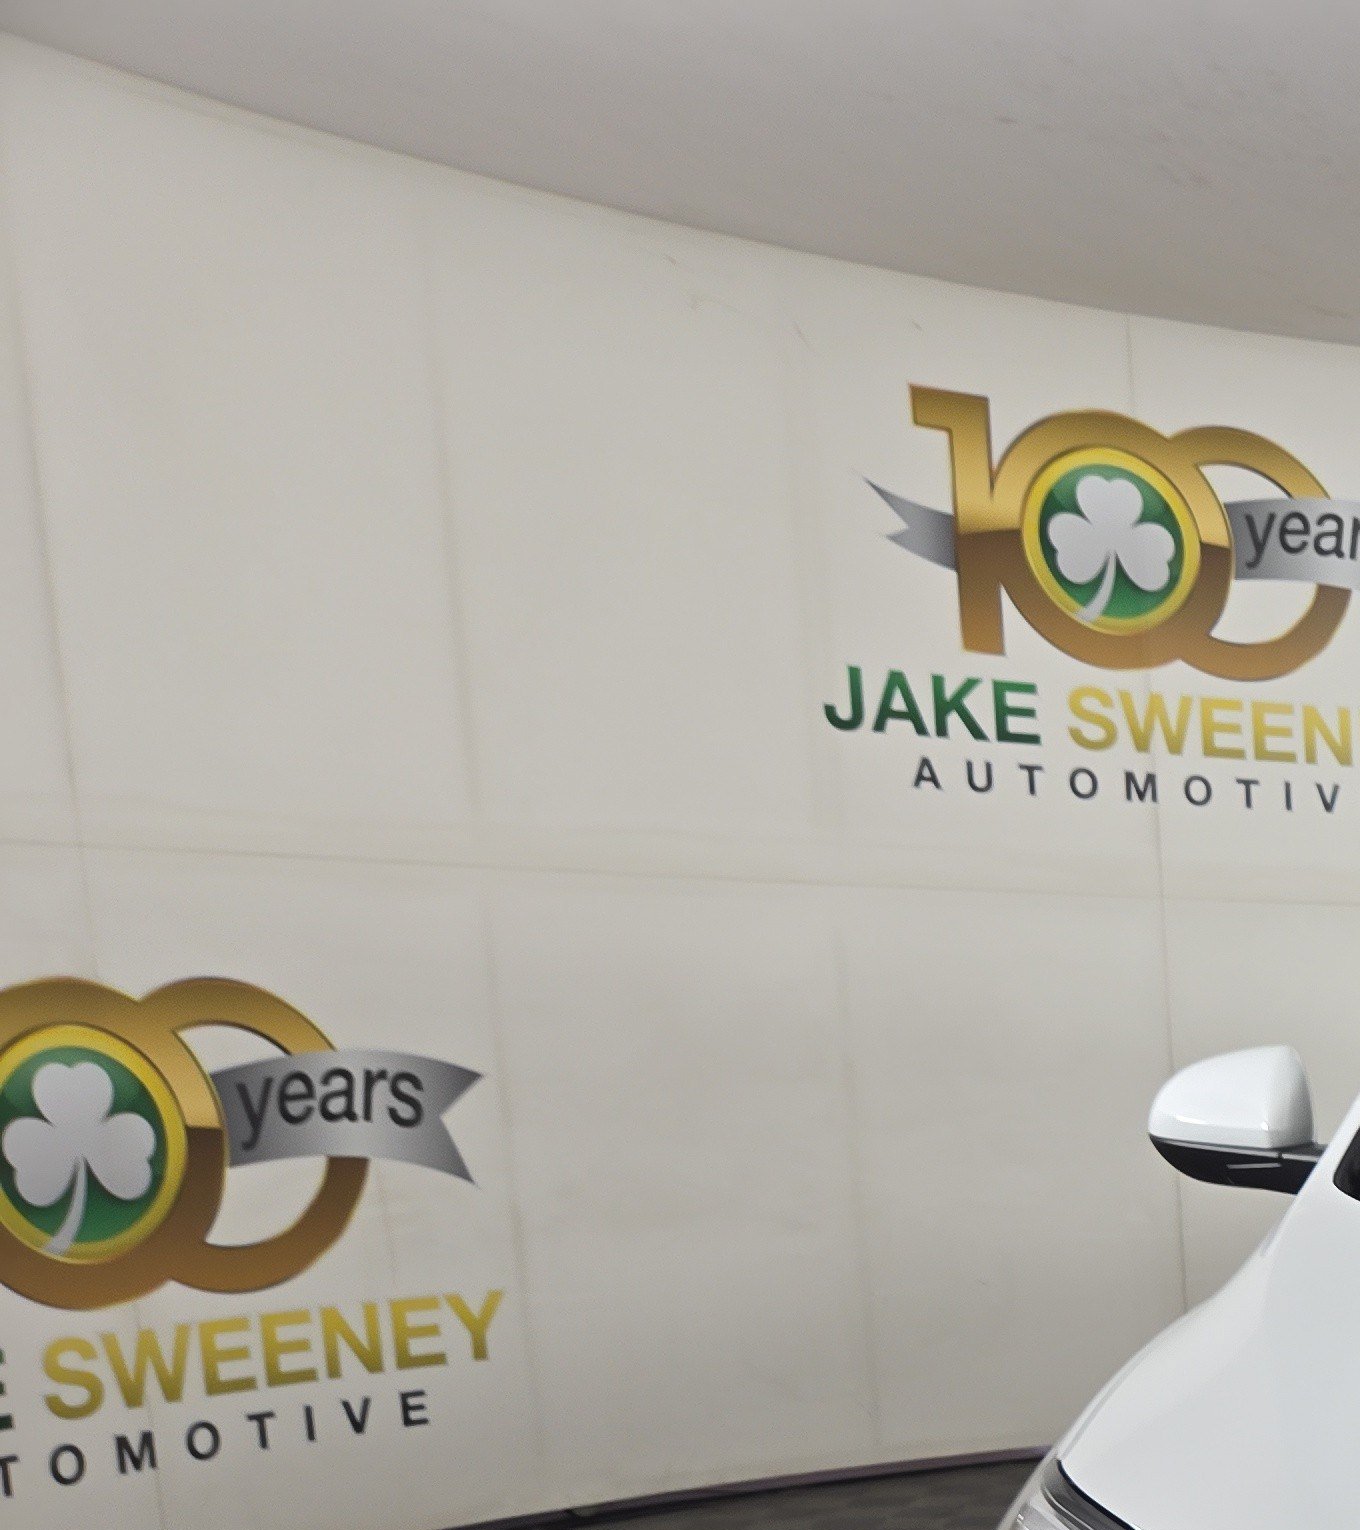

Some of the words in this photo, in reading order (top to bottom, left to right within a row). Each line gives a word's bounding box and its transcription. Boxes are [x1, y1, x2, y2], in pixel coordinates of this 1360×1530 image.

[909, 383, 1351, 682] 100
[824, 665, 1041, 745] JAKE
[236, 1067, 425, 1150] years
[43, 1289, 504, 1420] SWEENEY
